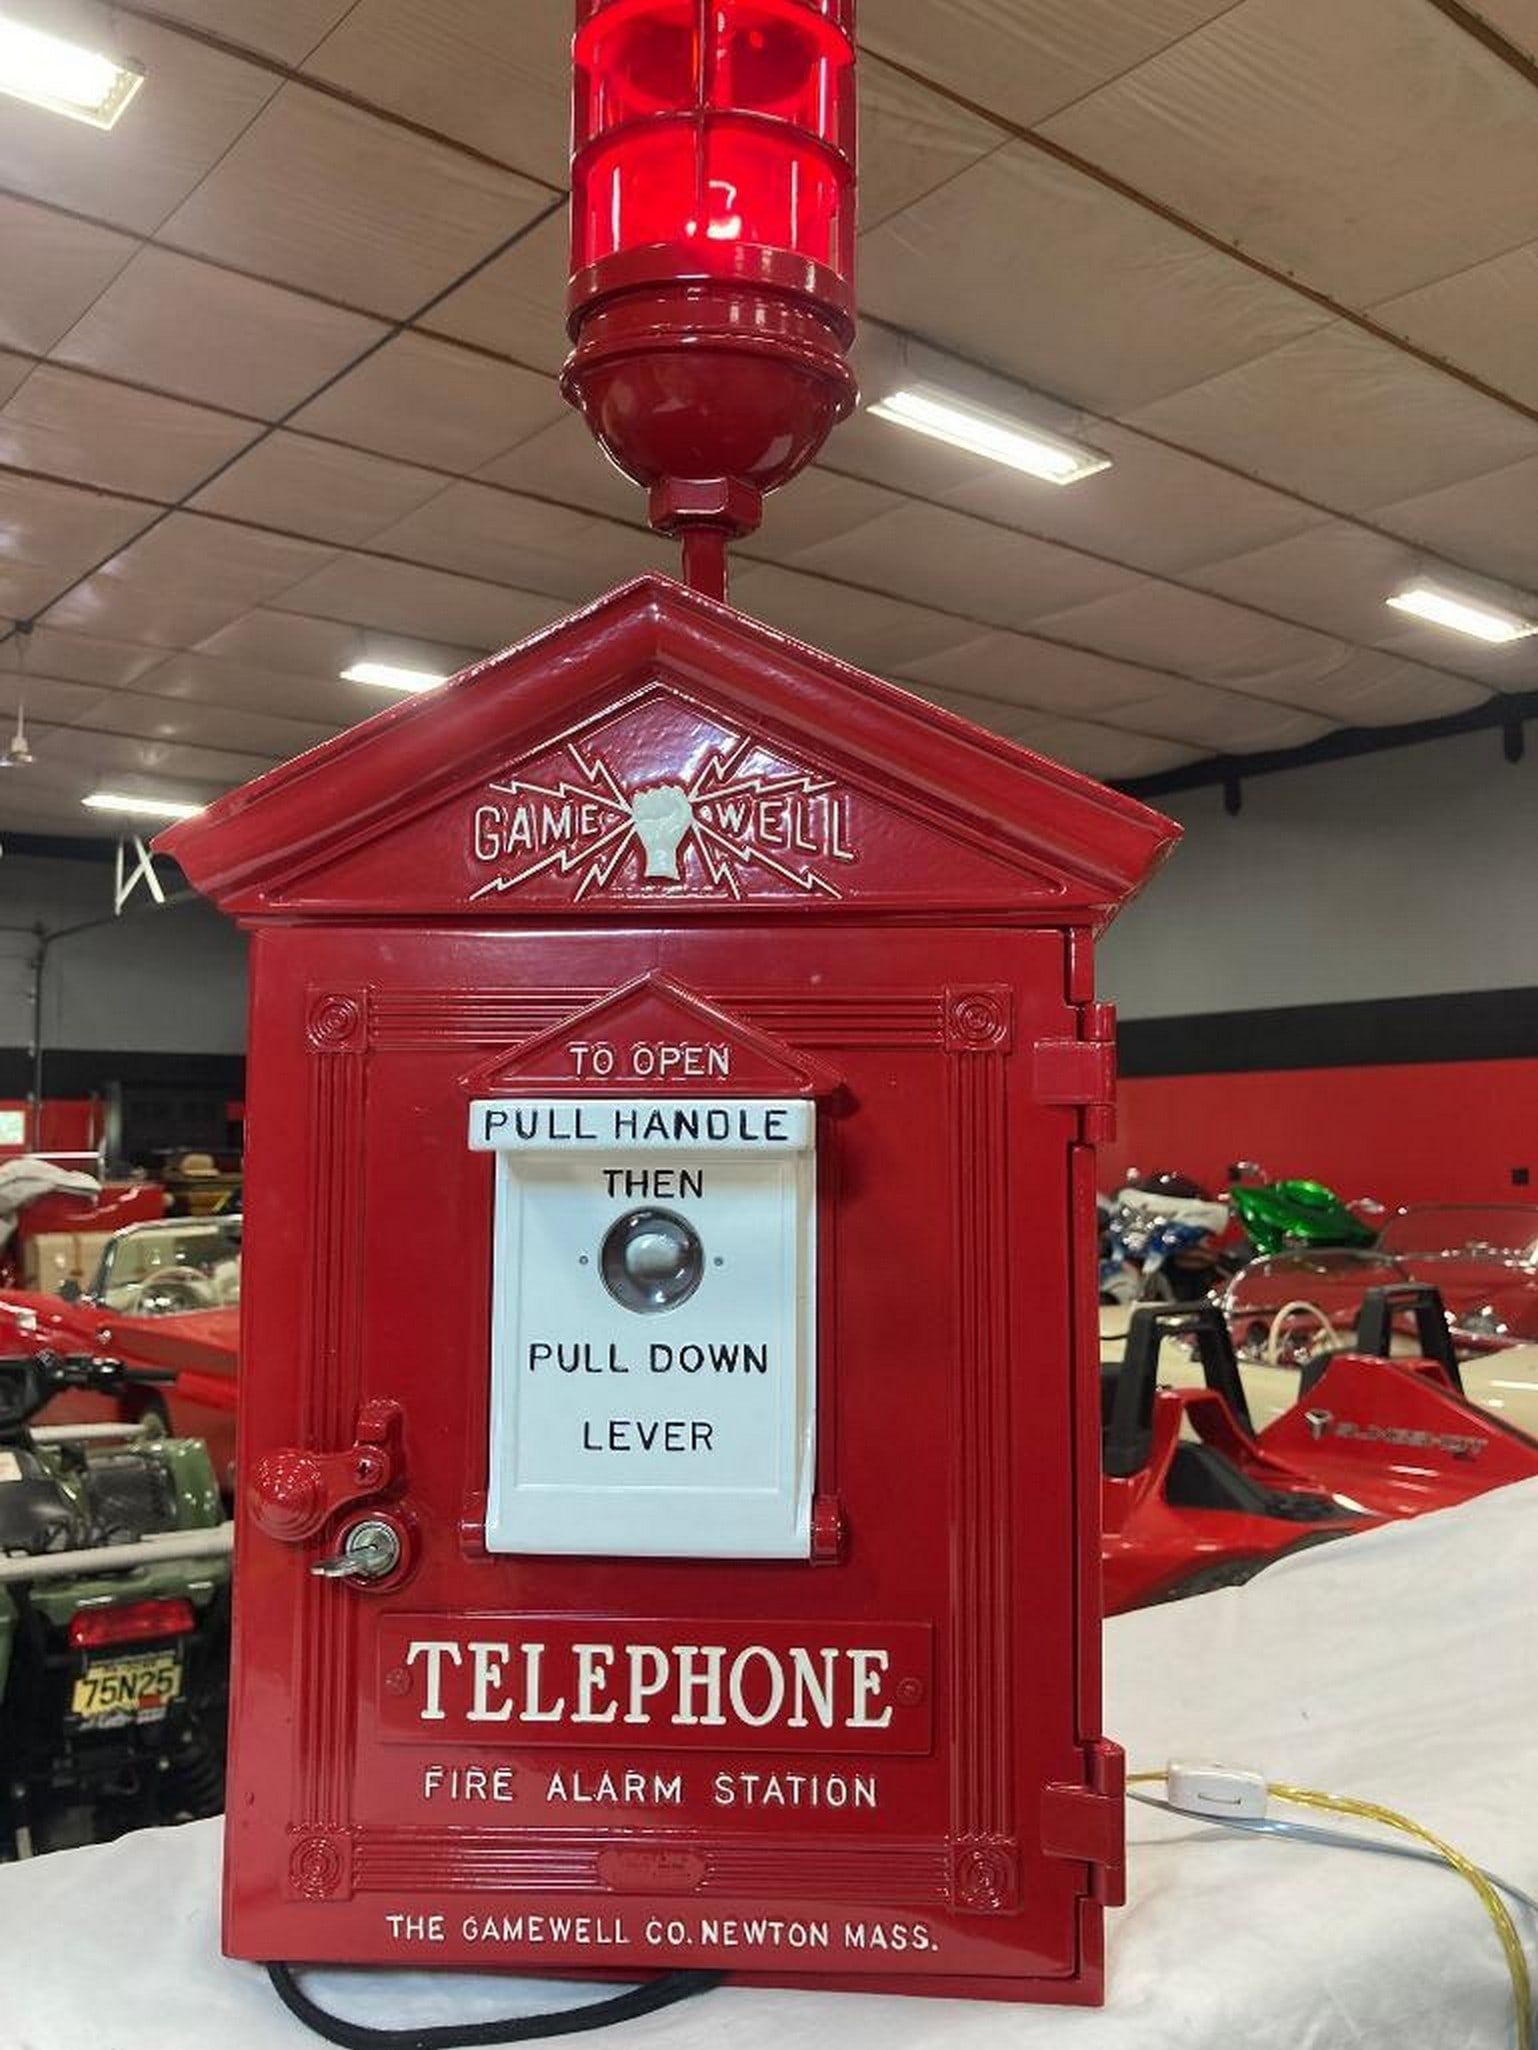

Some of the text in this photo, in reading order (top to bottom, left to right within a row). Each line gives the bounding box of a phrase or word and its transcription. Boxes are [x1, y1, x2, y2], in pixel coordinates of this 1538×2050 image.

[474, 794, 854, 860] GAME WELL
[570, 1046, 730, 1075] TO OPEN
[485, 1109, 789, 1141] PULL HANDLE
[603, 1169, 704, 1199] THEN
[529, 1343, 768, 1374] PULL DOWN
[584, 1421, 714, 1452] LEVER
[406, 1641, 894, 1728] TELEPHONE
[424, 1768, 878, 1808] FIRE ALARM STATION
[386, 1914, 445, 1942] THE
[462, 1916, 630, 1946] GAMEWELL
[702, 1920, 830, 1951] NEWTON
[845, 1923, 940, 1952] MASS.
